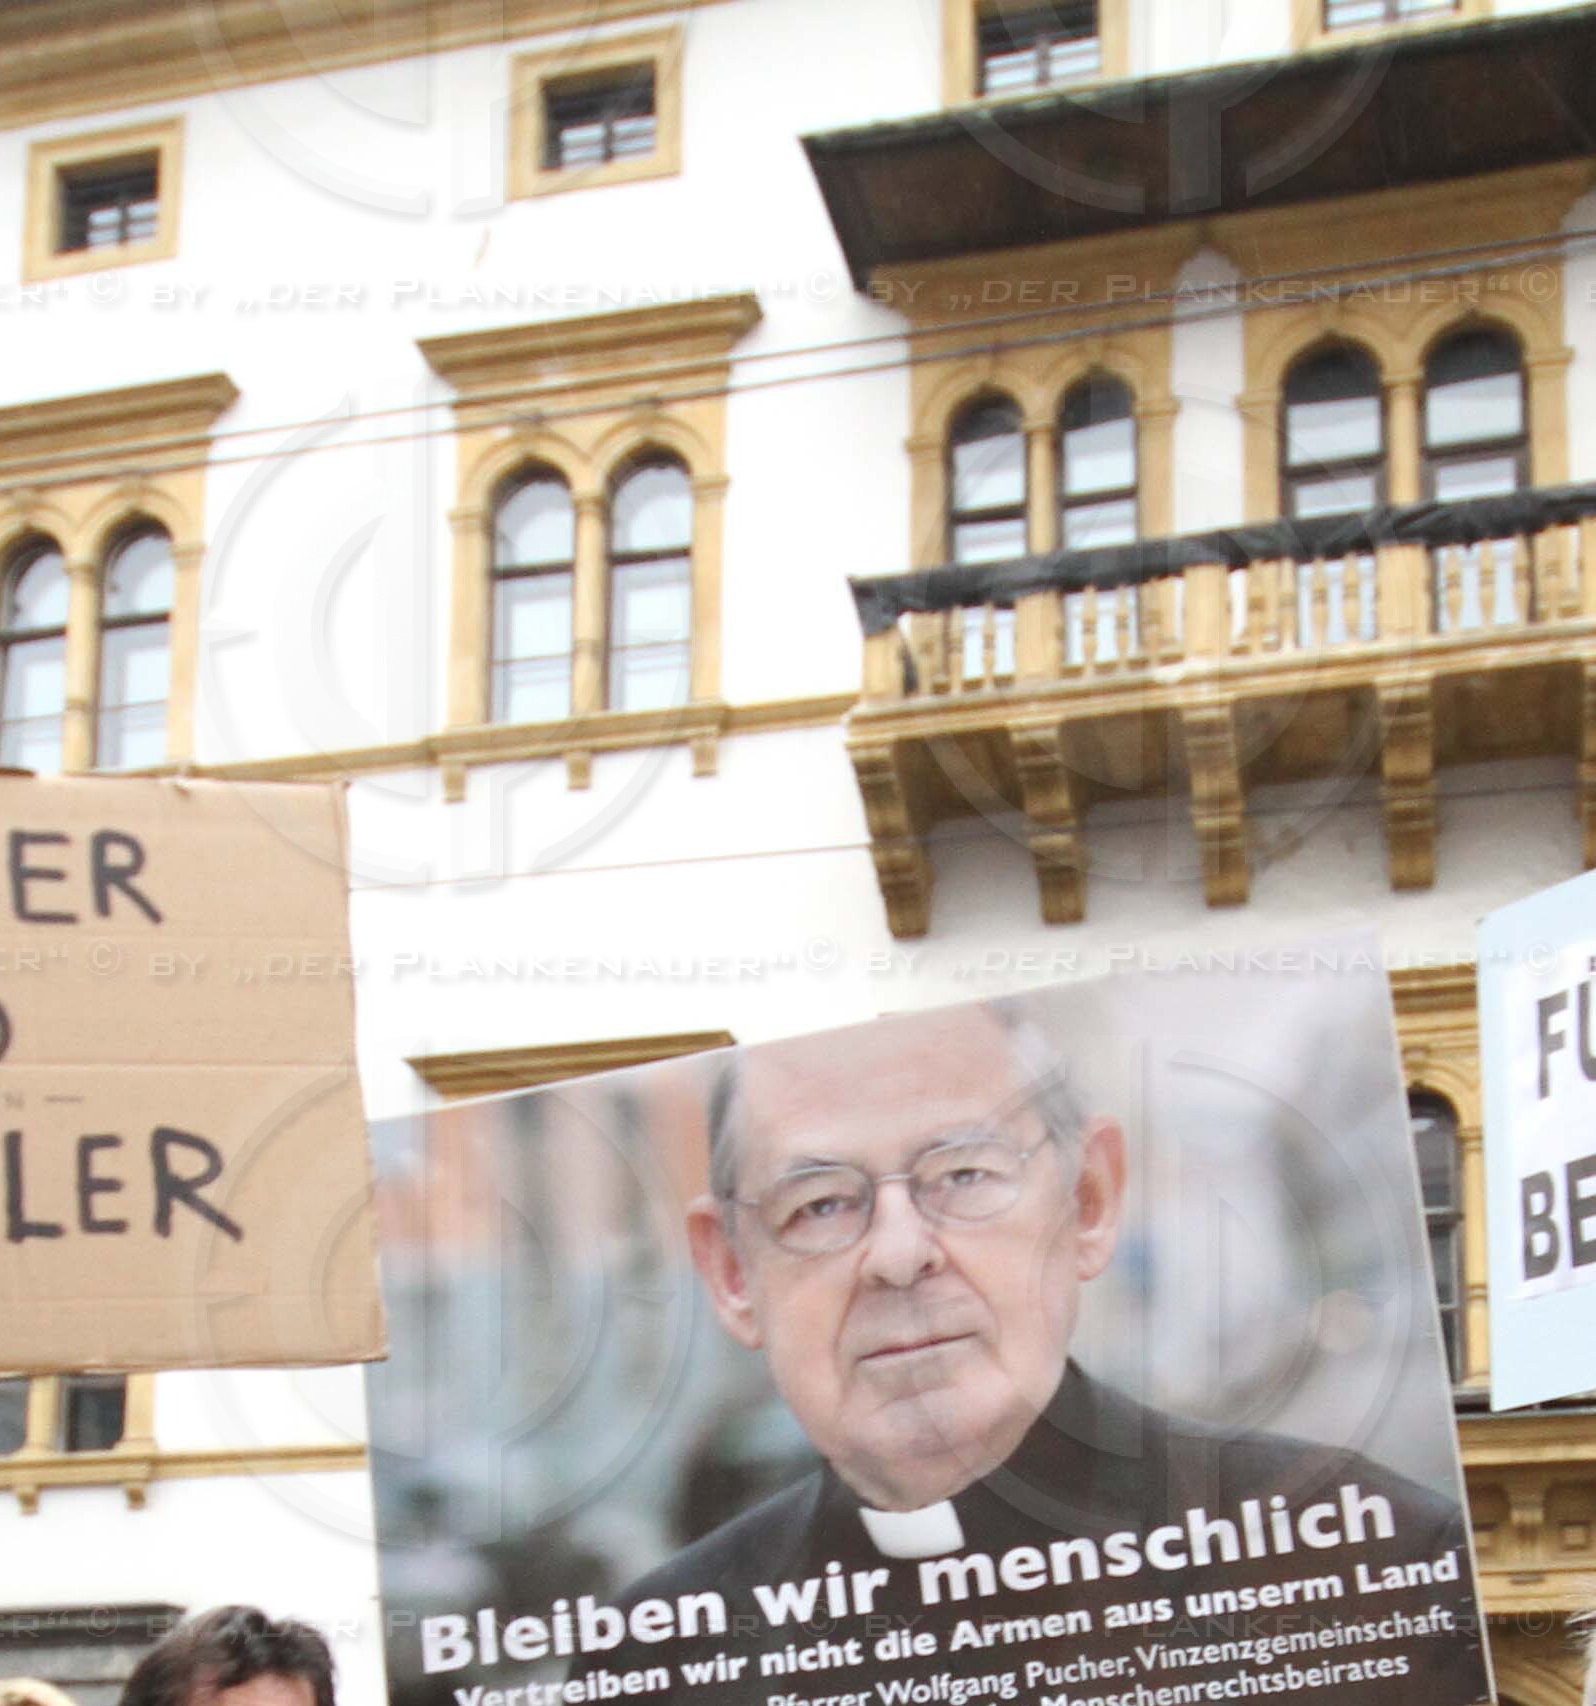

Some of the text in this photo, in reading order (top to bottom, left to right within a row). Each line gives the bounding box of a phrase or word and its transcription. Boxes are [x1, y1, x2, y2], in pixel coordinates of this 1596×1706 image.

[419, 1483, 1396, 1674] Bleiben wir menschlich
[681, 1652, 748, 1687] wir
[759, 1636, 864, 1677] nicht
[874, 1625, 938, 1673] die
[949, 1609, 1093, 1652] Armen
[1103, 1597, 1174, 1629] aus
[1185, 1572, 1345, 1617] unserm
[1354, 1550, 1460, 1596] Land
